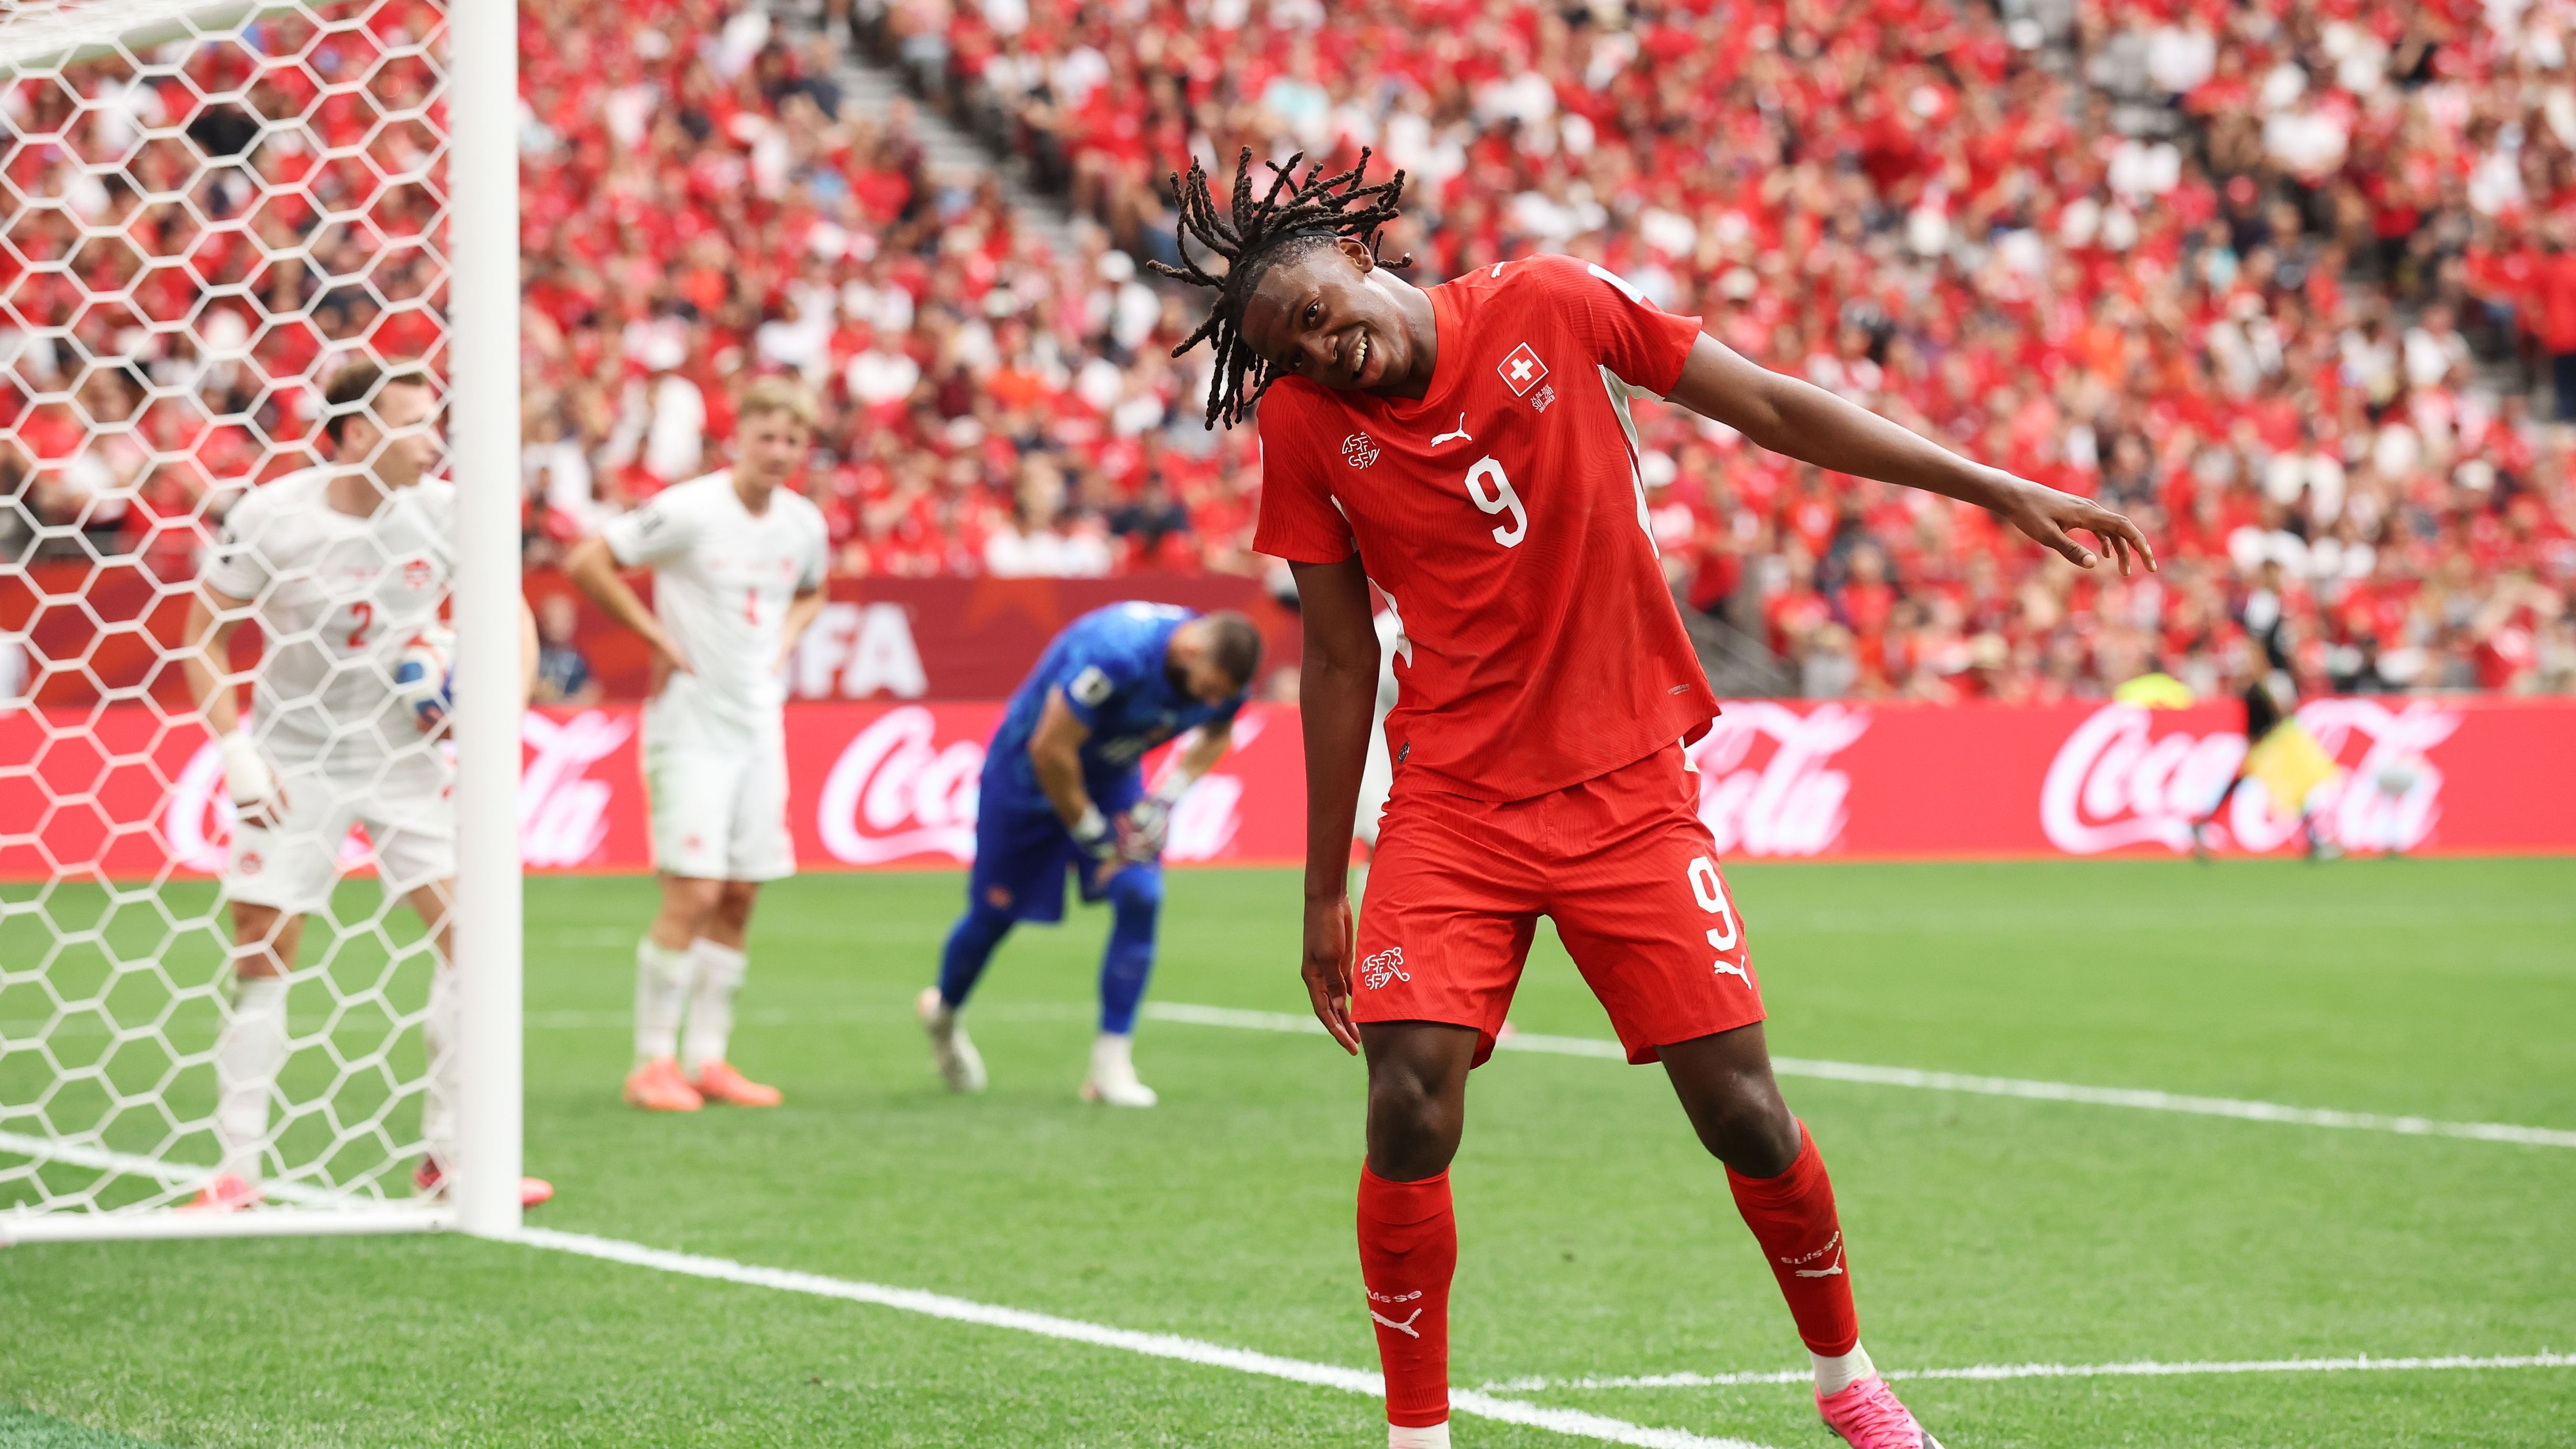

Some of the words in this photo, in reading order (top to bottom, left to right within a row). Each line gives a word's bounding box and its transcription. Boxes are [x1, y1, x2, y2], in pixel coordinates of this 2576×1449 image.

[1532, 399, 1543, 410] SUI
[1465, 454, 1528, 548] 9
[346, 601, 373, 649] 2
[1687, 856, 1737, 952] 9
